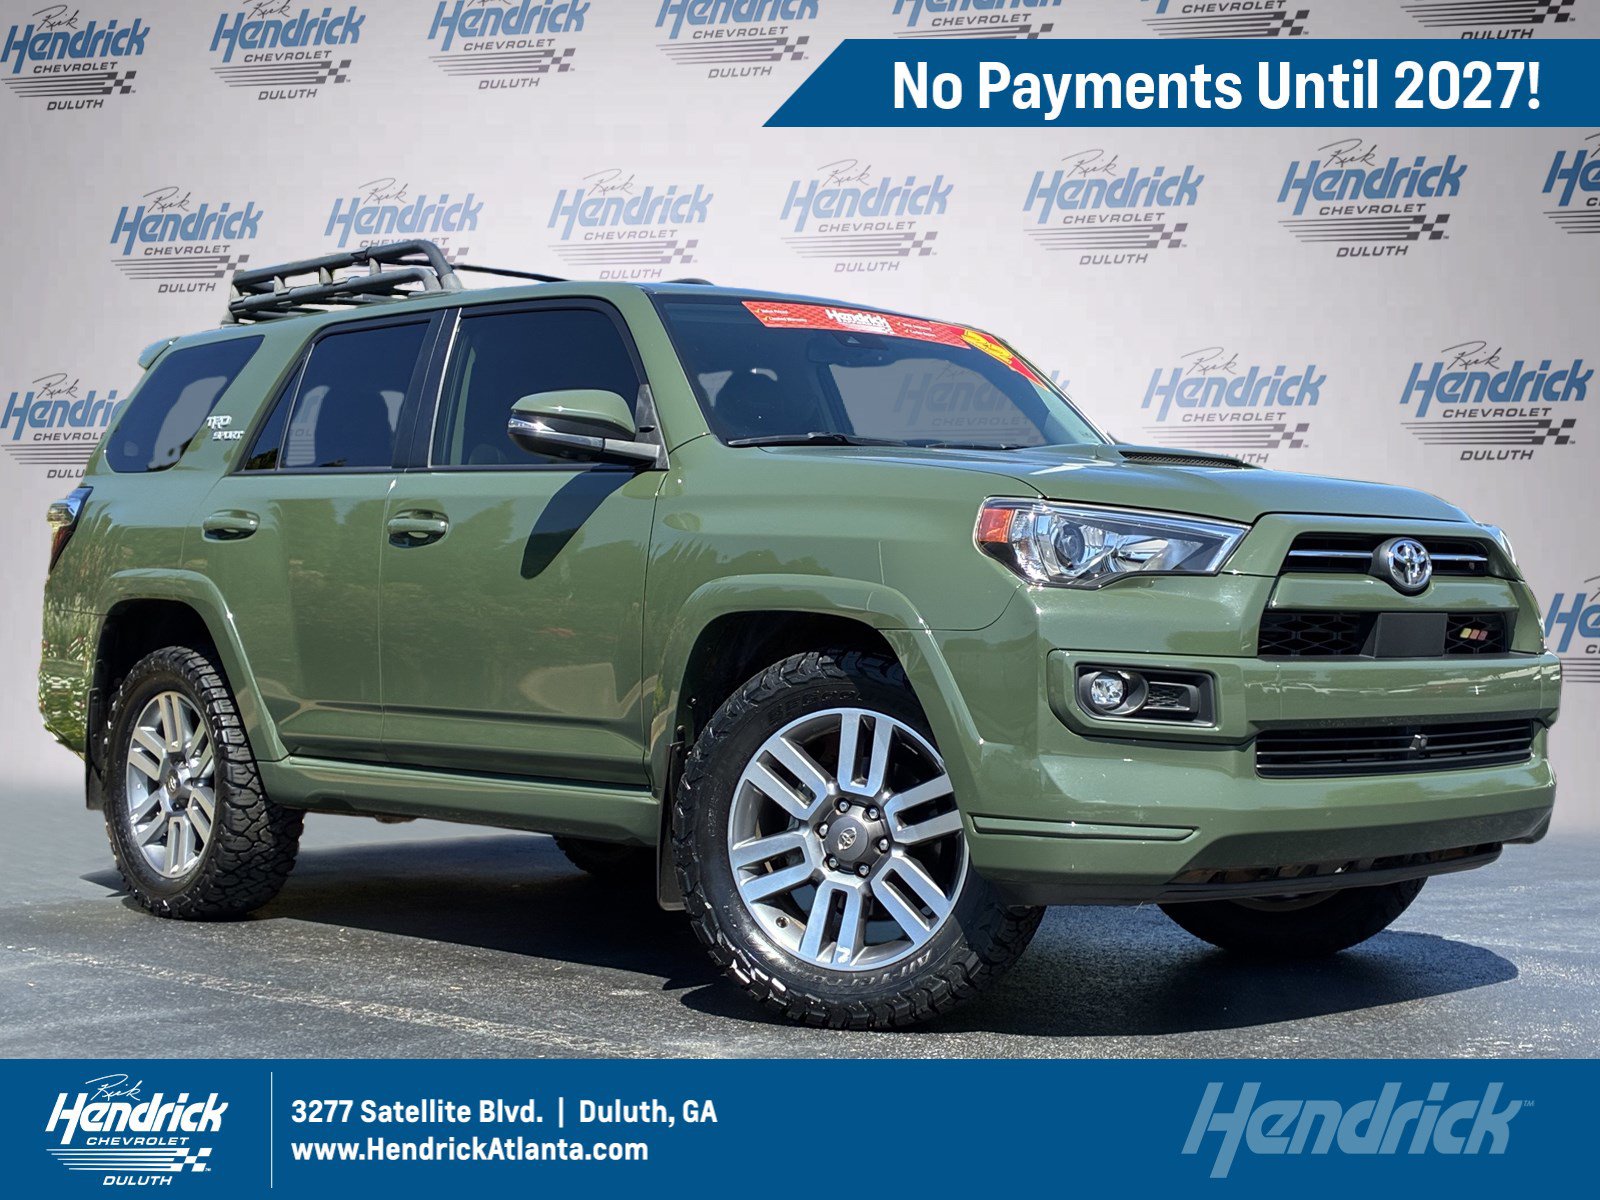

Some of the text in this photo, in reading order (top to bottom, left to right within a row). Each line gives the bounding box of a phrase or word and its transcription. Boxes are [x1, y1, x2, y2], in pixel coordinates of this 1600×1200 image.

[1182, 0, 1287, 14] CHEVROLET
[427, 0, 590, 51] Hendrick
[931, 13, 1032, 26] CHEVROLET
[209, 5, 366, 63] Hendrick
[692, 26, 788, 39] CHEVROLET
[1461, 29, 1534, 39] DULUTH
[0, 18, 151, 74] Hendrick
[464, 38, 556, 51] CHEVROLET
[244, 50, 333, 63] CHEVROLET
[33, 61, 118, 74] CHEVROLET
[707, 66, 772, 79] DULUTH
[478, 77, 541, 90] DULUTH
[258, 88, 318, 101] DULUTH
[46, 98, 104, 111] DULUTH
[1277, 154, 1468, 215] Hendrick
[1022, 164, 1205, 224] Hendrick
[779, 174, 953, 233] Hendrick
[1319, 203, 1426, 216] CHEVROLET
[547, 183, 714, 240] Hendrick
[324, 192, 483, 248] Hendrick
[1063, 212, 1165, 225] CHEVROLET
[110, 201, 263, 256] Hendrick
[818, 221, 916, 233] CHEVROLET
[584, 229, 678, 240] CHEVROLET
[144, 244, 230, 256] CHEVROLET
[1336, 245, 1409, 258] DULUTH
[1079, 253, 1148, 265] DULUTH
[834, 261, 900, 273] DULUTH
[599, 268, 662, 280] DULUTH
[158, 282, 216, 294] DULUTH
[1141, 364, 1327, 422] Hendrick
[1399, 359, 1594, 418] Hendrick
[0, 390, 127, 440] Hendri
[1182, 412, 1287, 423] CHEVROLET
[1442, 407, 1552, 418] CHEVROLET
[206, 415, 232, 430] TRD
[33, 432, 105, 441] CHEVROL
[212, 430, 245, 441] SPORT
[1460, 449, 1534, 461] DULUTH
[47, 469, 85, 478] DULU
